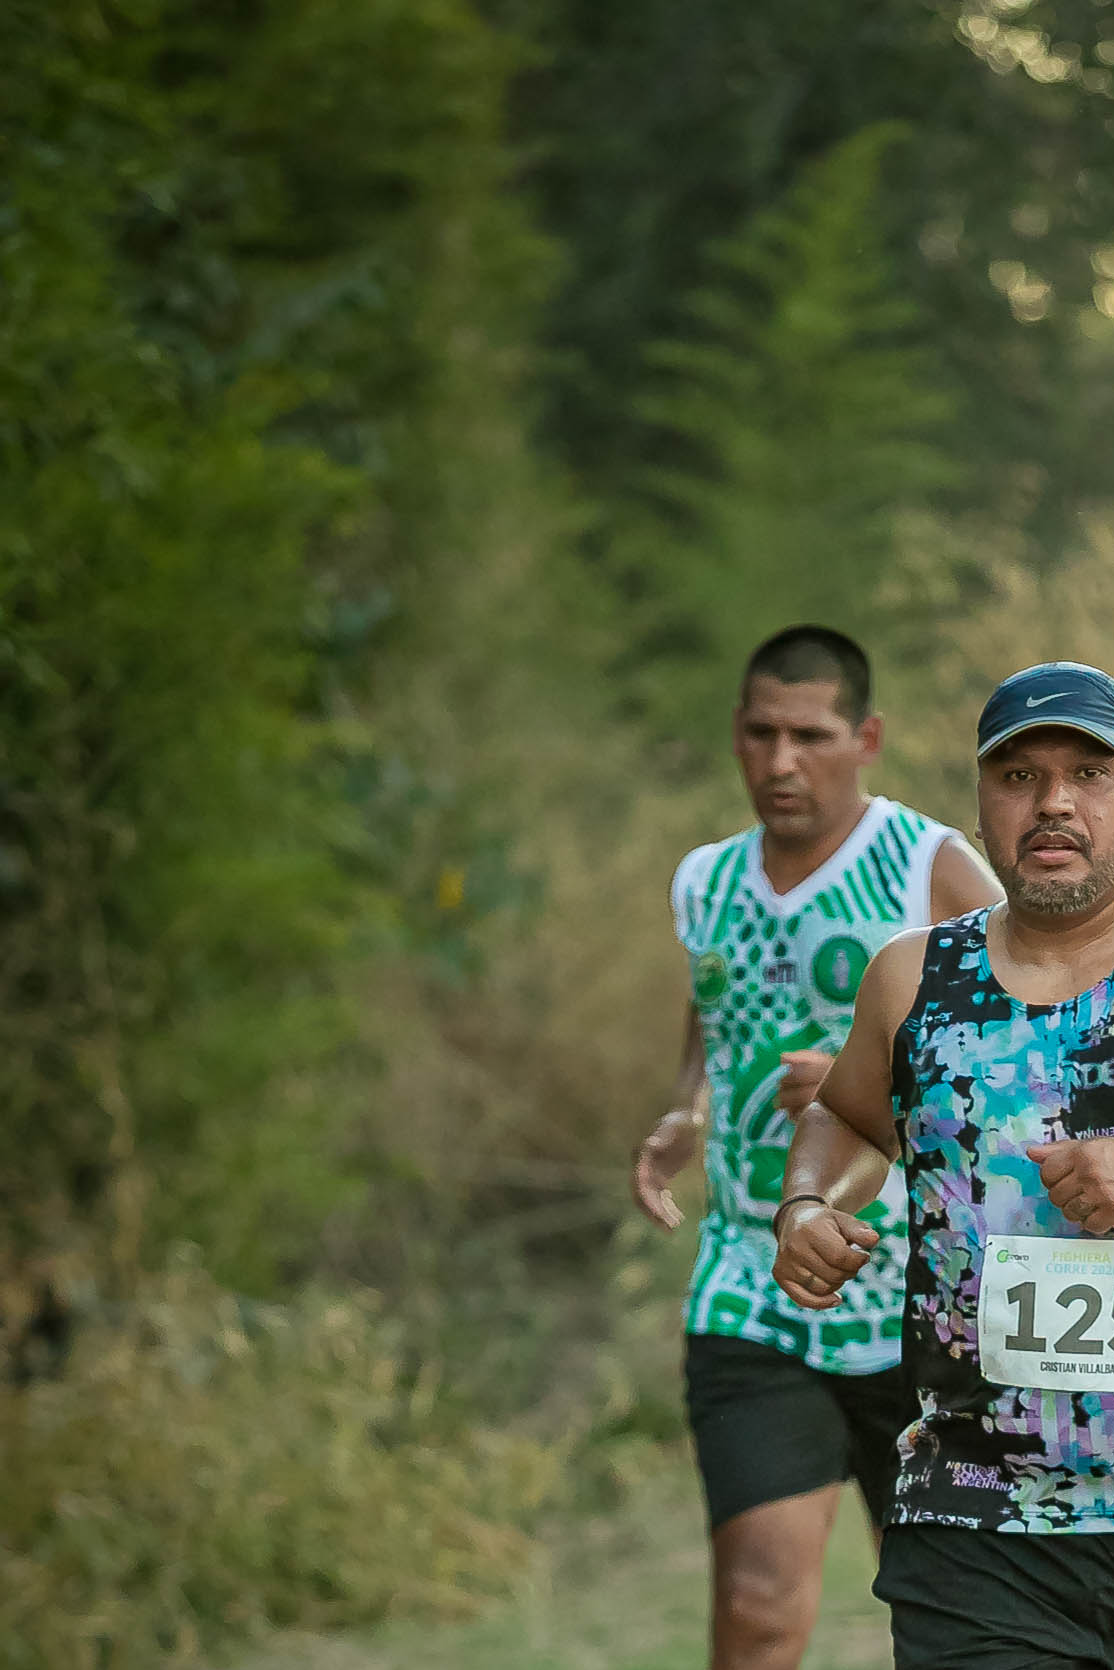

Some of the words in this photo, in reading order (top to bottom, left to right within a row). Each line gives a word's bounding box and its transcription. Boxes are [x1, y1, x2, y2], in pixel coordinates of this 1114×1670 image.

[1045, 1263, 1088, 1275] CORRE
[1040, 1361, 1076, 1373] CRISTIAN
[1079, 1363, 1114, 1374] VILLALBA
